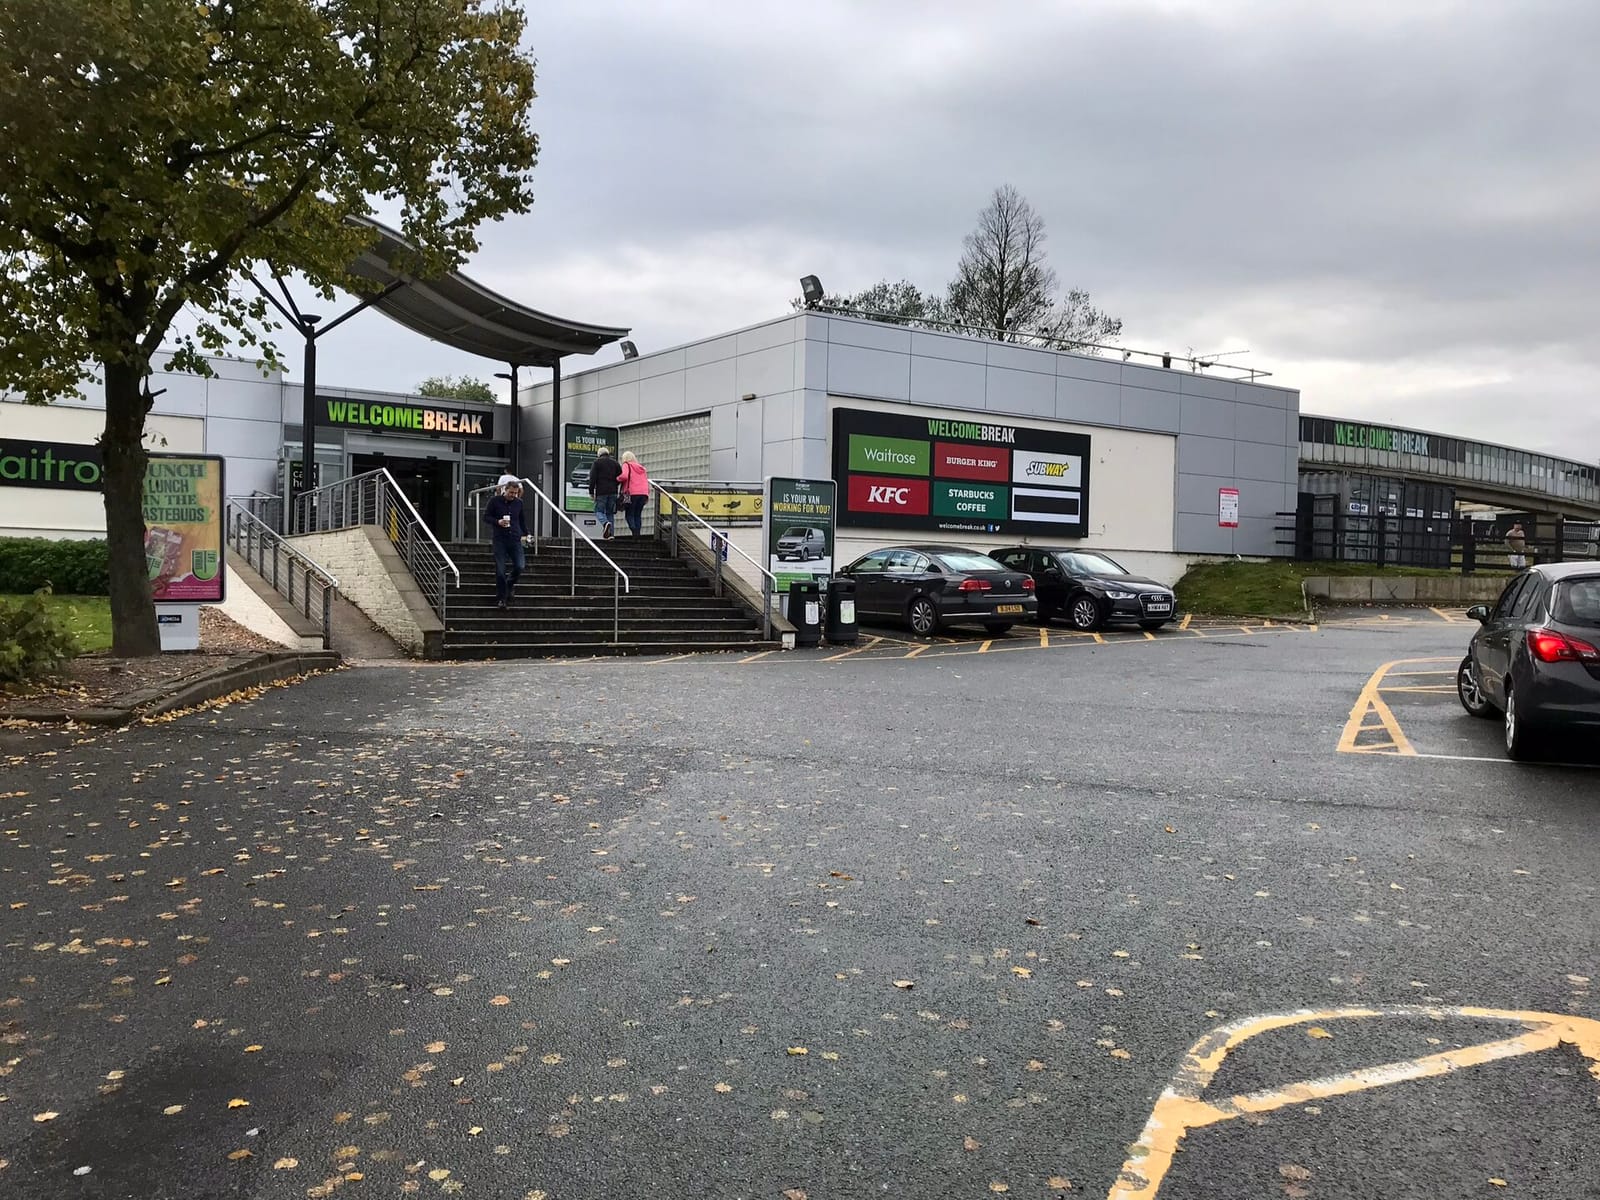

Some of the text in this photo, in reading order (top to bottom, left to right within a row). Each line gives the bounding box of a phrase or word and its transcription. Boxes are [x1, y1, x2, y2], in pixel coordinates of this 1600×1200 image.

[327, 400, 484, 434] WELCOMEBREAK
[928, 420, 1016, 443] WELCOMEBREAK
[1335, 423, 1429, 455] WELCOMEBREAK
[864, 447, 916, 465] Waitrose
[946, 457, 998, 468] BURGER KING
[0, 447, 105, 484] aitro
[147, 464, 204, 478] UNCH
[1026, 461, 1069, 477] SUBWAY
[148, 480, 189, 493] LUNCH
[164, 495, 197, 505] THE
[783, 493, 820, 504] IS YOUR VAN
[867, 486, 909, 505] KFC
[948, 489, 995, 500] STARBUCKS
[773, 502, 831, 514] WORKING FOR YOU?
[956, 502, 987, 512] COFFEE
[142, 507, 205, 522] ASTEBUDS
[939, 522, 986, 531] welcomebreak.co.uk
